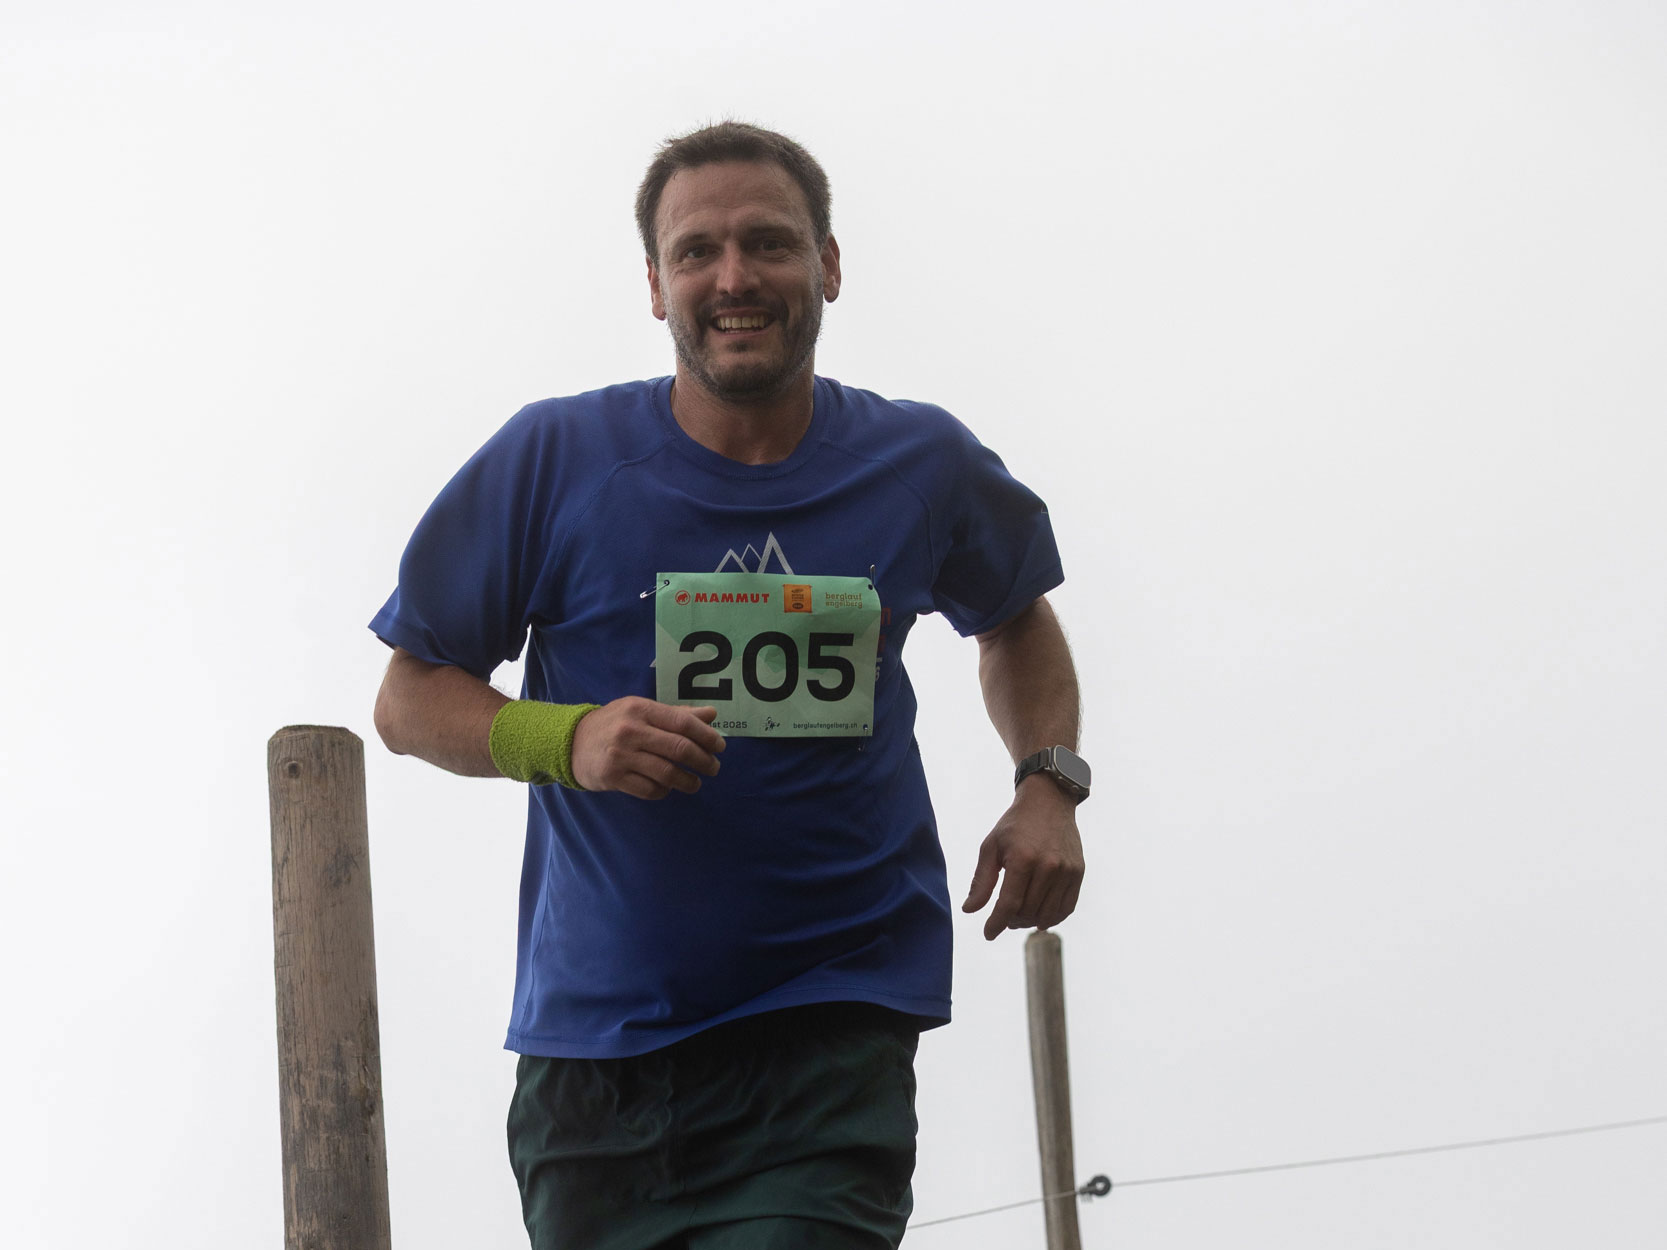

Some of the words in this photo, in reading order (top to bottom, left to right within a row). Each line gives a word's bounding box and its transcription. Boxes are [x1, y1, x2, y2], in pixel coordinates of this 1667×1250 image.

[694, 592, 770, 604] MAMMUT
[825, 592, 862, 601] berglauf
[825, 600, 863, 609] engelberg
[677, 630, 857, 703] 205
[723, 721, 748, 729] 2025
[793, 721, 858, 730] berglaufengelberg.ch
